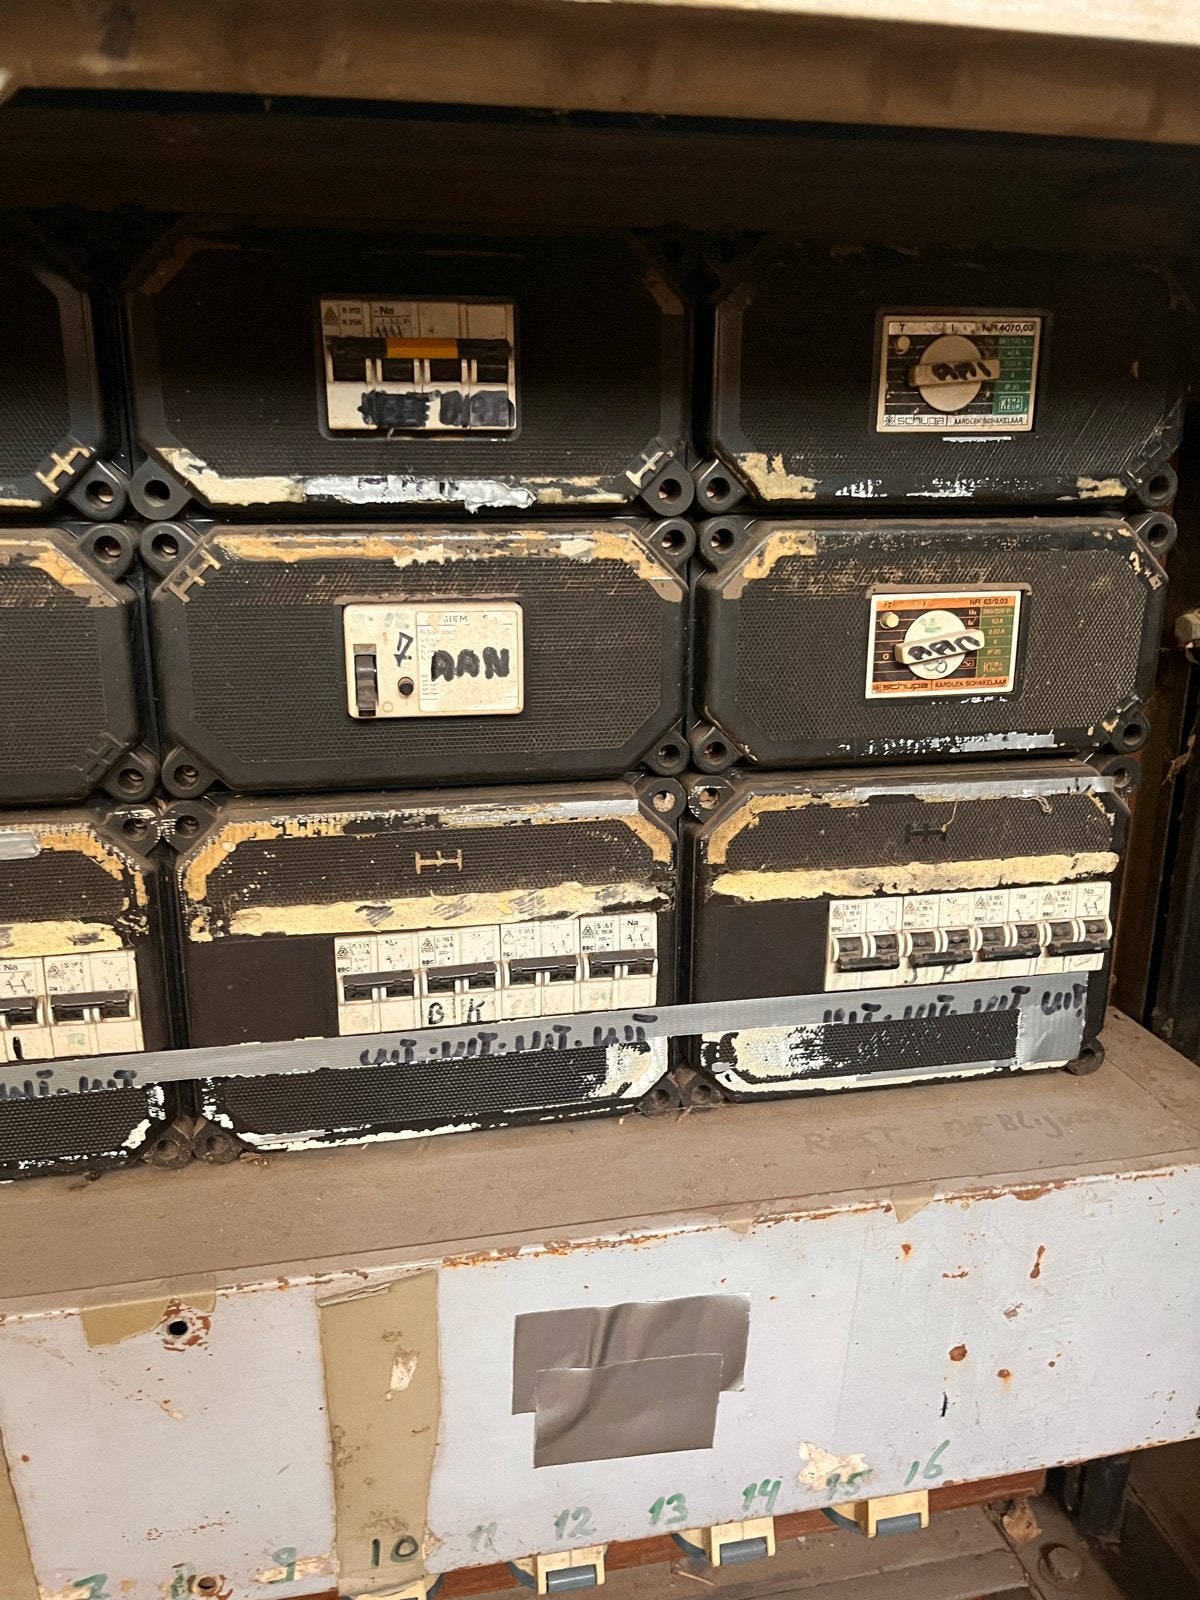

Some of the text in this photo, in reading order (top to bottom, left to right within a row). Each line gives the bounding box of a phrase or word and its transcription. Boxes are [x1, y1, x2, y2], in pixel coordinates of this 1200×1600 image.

[431, 646, 510, 682] AAN
[371, 1535, 419, 1568] 10
[553, 1505, 596, 1541] 12
[648, 1492, 689, 1526] 13
[742, 1478, 782, 1512] 14
[826, 1467, 874, 1500] 15
[904, 1439, 950, 1487] 16
